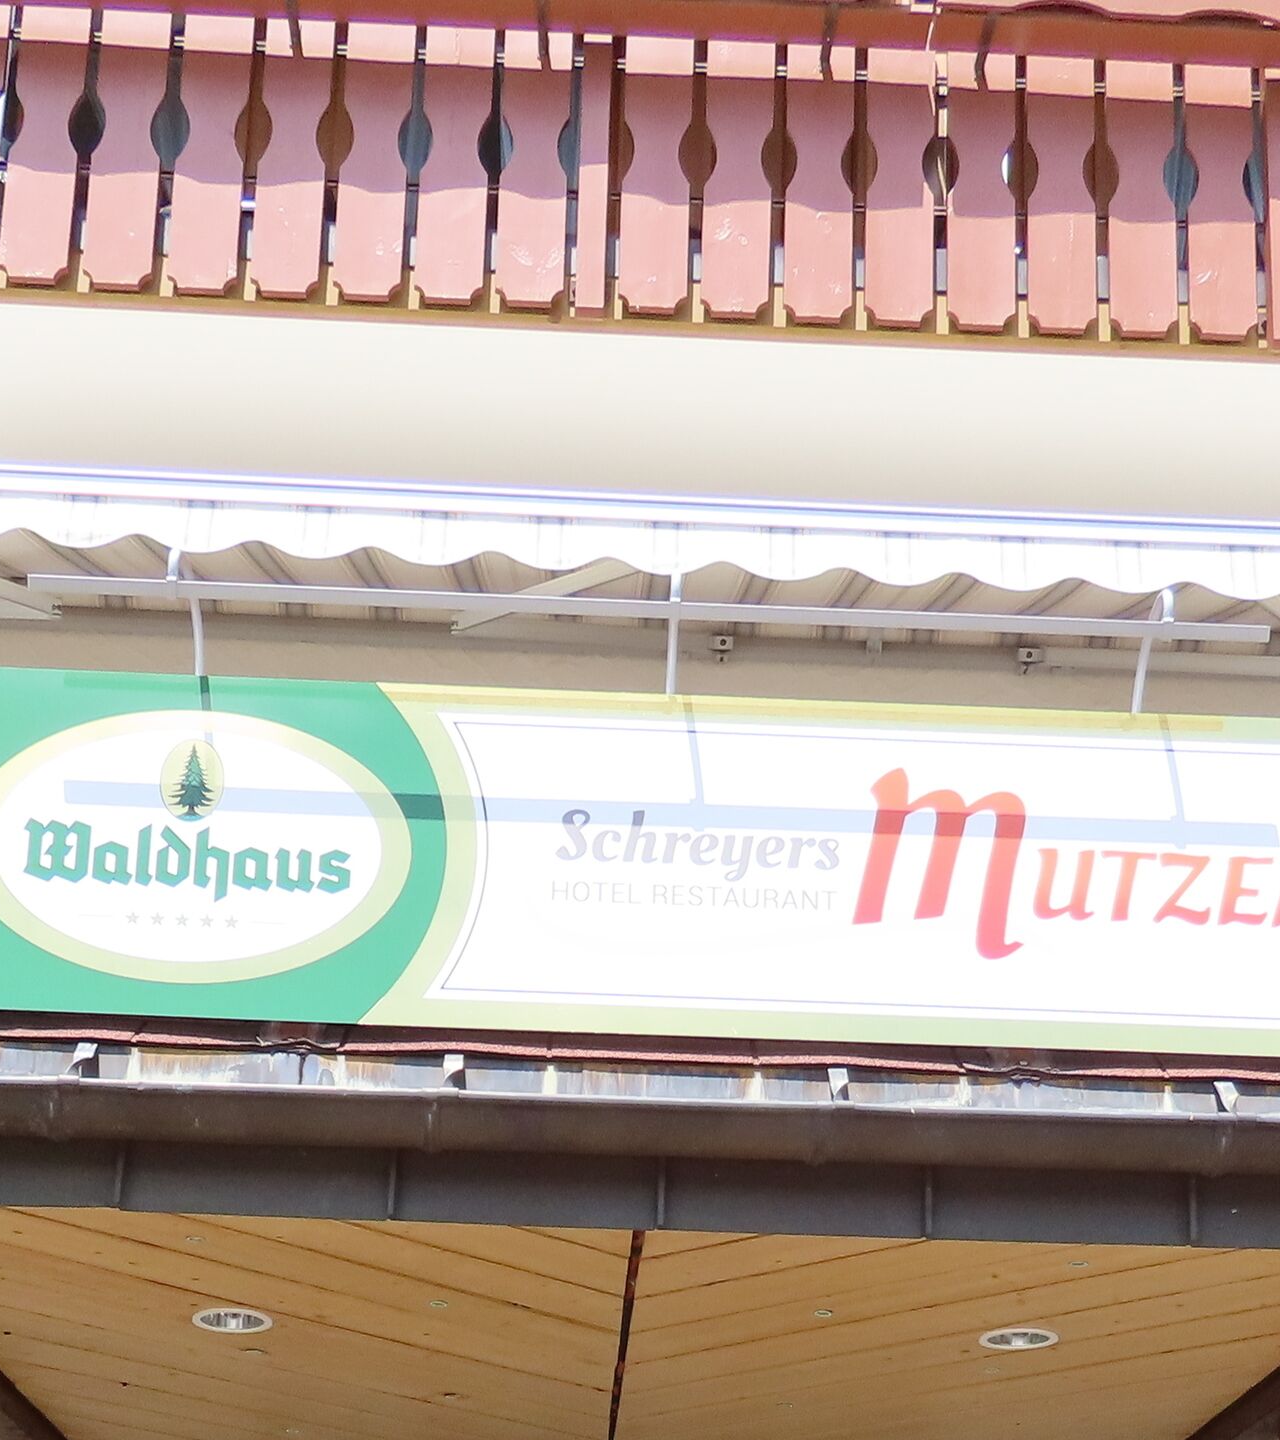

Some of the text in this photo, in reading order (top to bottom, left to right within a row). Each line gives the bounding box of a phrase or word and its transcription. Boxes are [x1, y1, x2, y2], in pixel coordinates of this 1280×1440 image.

[23, 817, 352, 903] Waldhaus
[554, 808, 841, 882] Schreyers
[551, 880, 838, 912] HOTEL RESTAURANT
